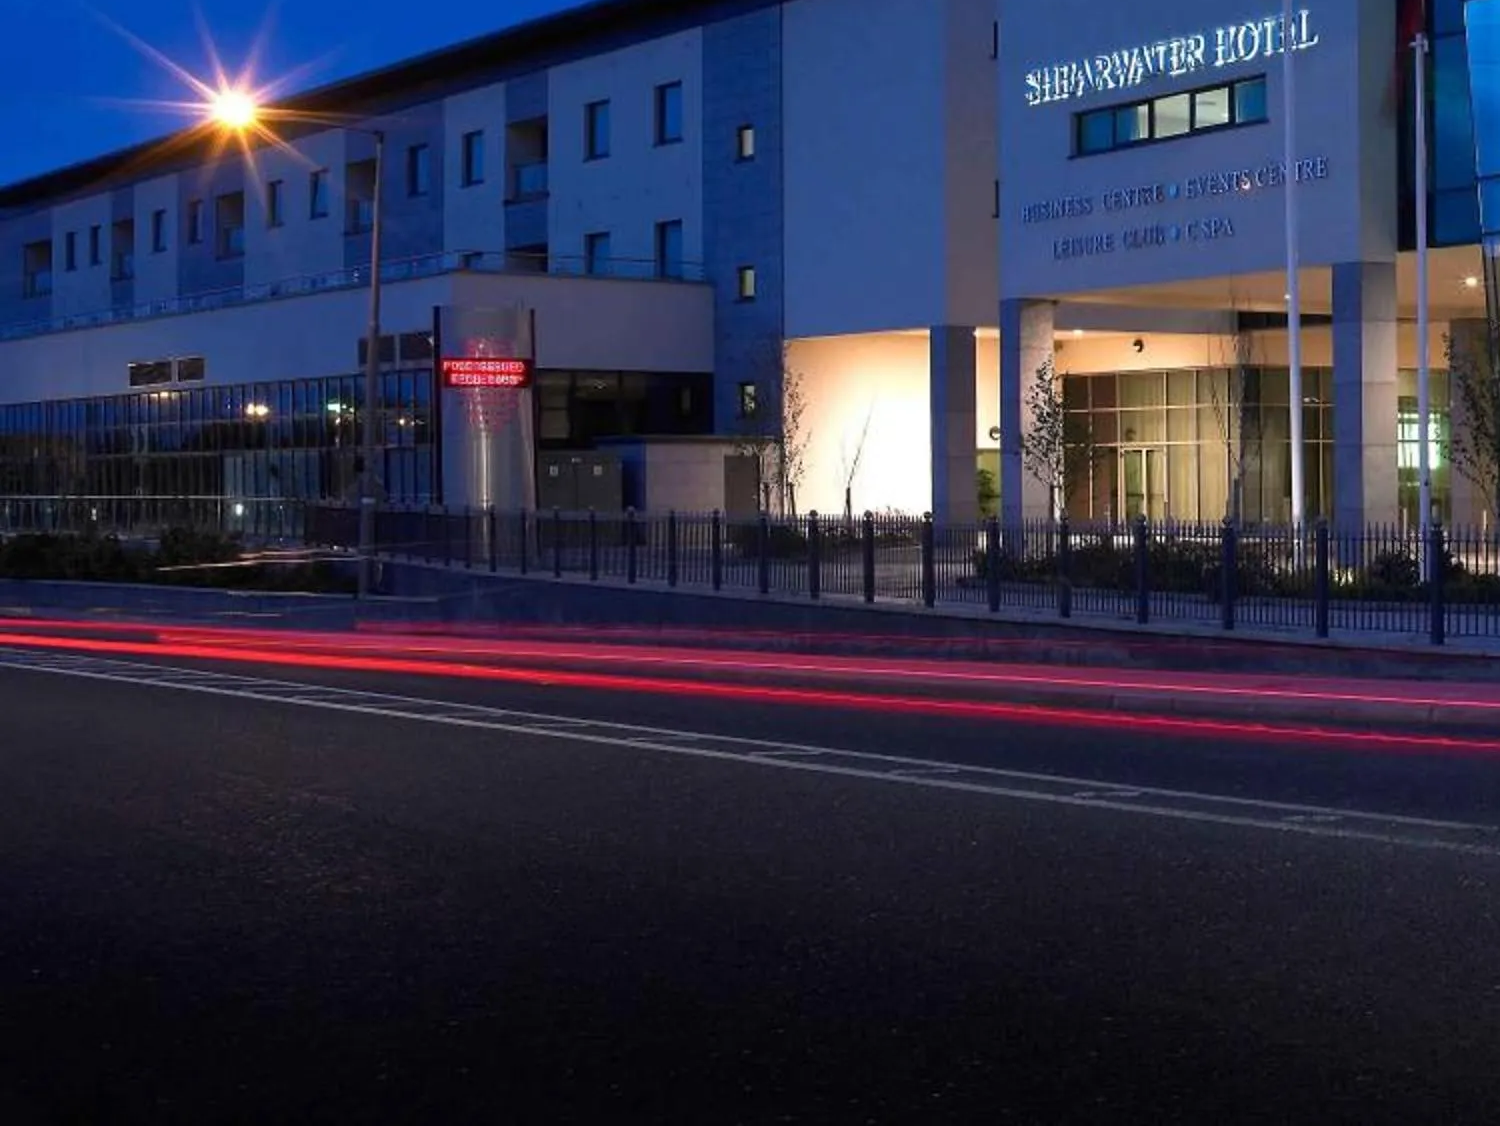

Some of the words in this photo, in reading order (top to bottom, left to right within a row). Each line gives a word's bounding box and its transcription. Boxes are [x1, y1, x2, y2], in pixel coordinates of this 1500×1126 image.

[1025, 36, 1205, 105] SHEARWATER
[1103, 183, 1165, 212] CENTRE
[1185, 169, 1251, 199] EVENTS
[1123, 225, 1166, 250] CLUB
